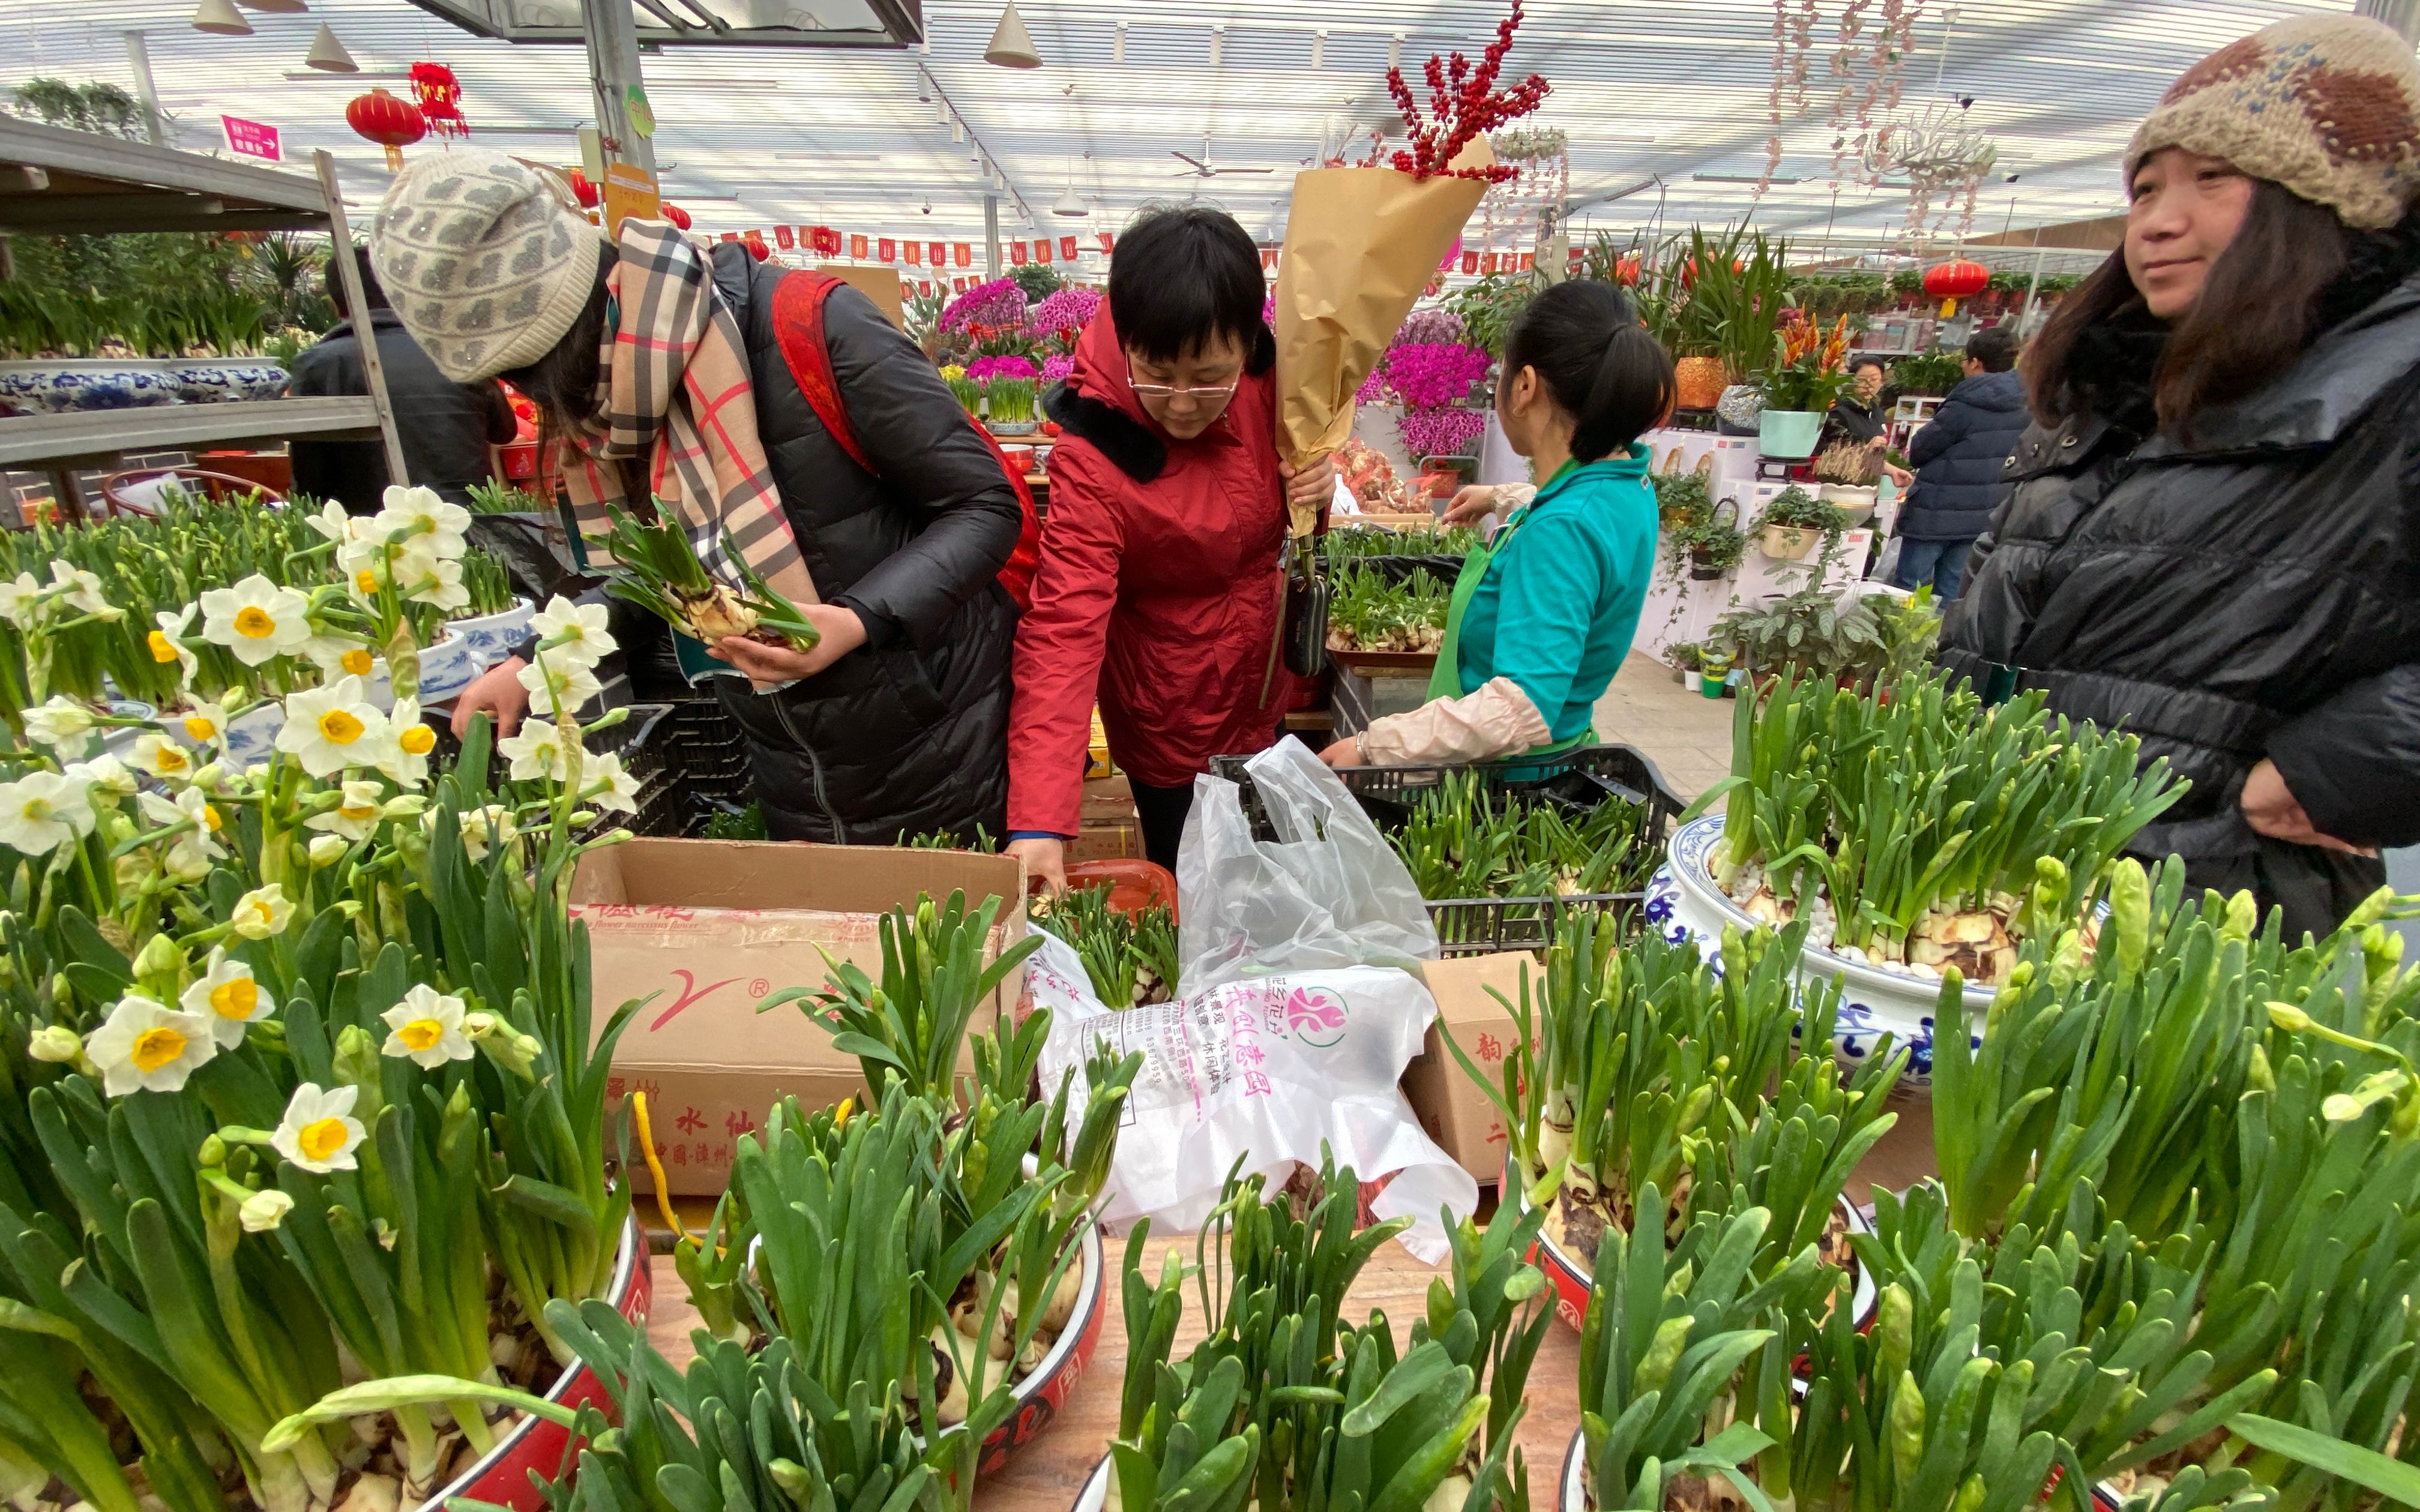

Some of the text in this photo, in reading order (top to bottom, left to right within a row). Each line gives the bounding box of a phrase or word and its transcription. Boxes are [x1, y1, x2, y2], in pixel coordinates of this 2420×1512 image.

[625, 921, 667, 929] narcissus
[670, 921, 699, 930] flower
[1203, 1042, 1221, 1096] 休闲体验
[676, 1106, 754, 1138] 水仙
